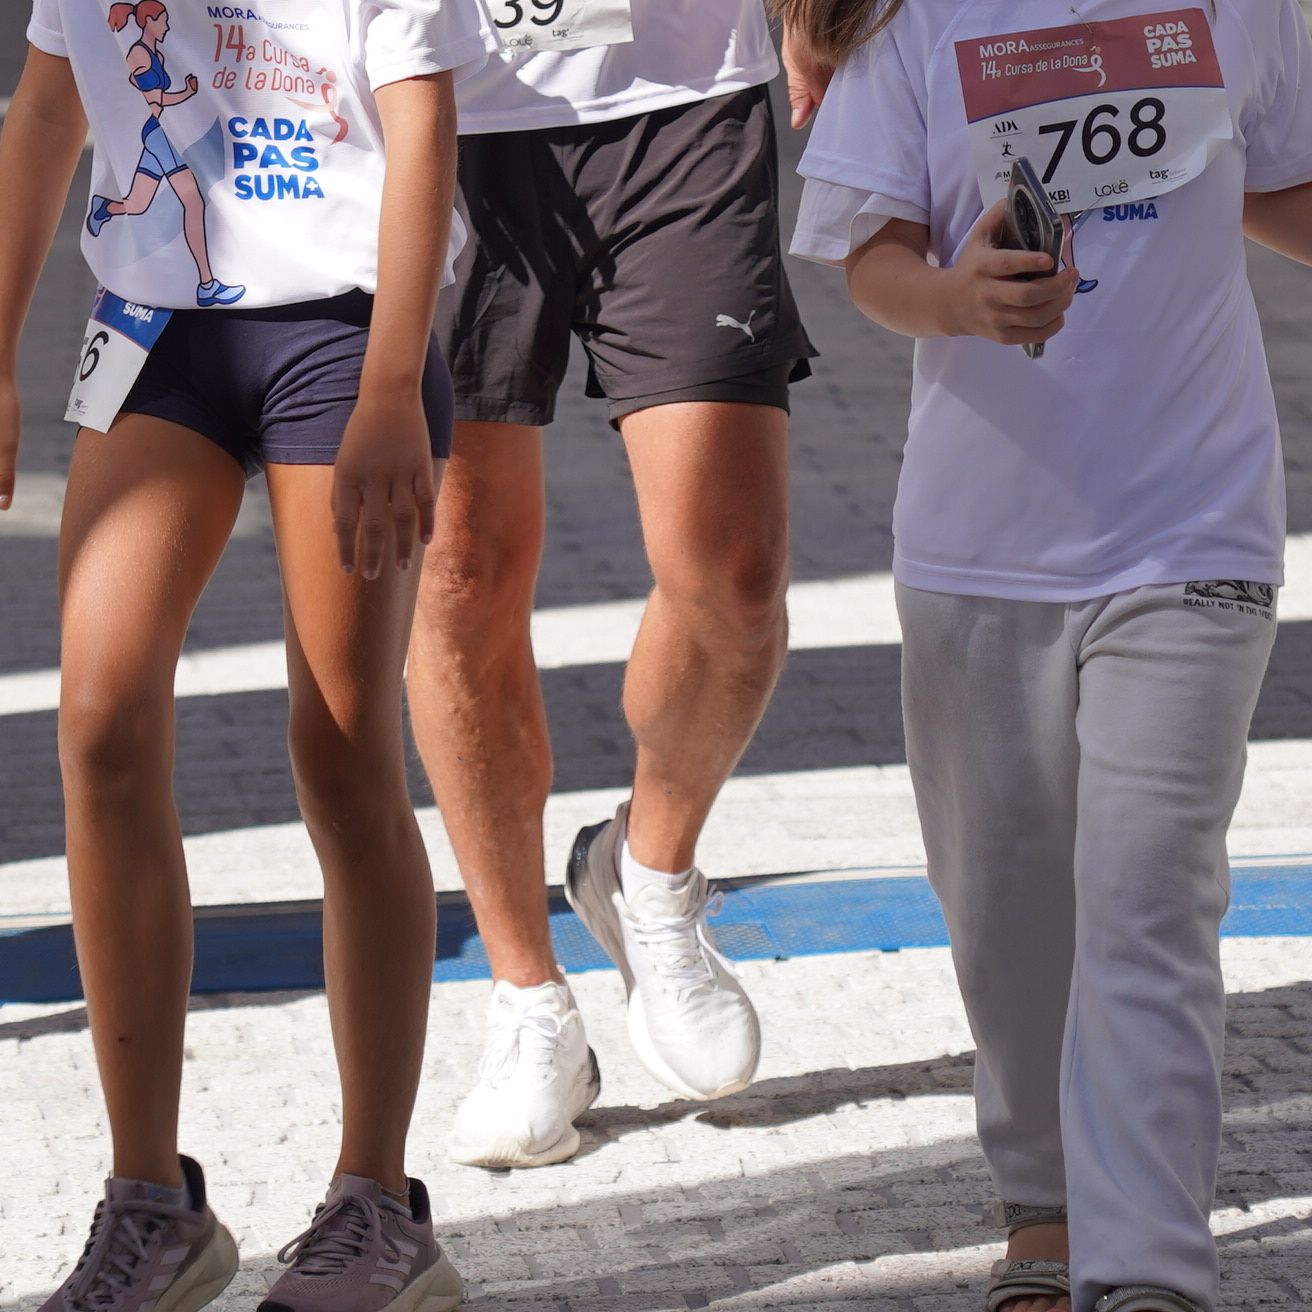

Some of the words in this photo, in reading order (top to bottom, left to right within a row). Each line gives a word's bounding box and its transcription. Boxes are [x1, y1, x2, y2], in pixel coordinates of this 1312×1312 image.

[207, 6, 258, 21] MORA
[1143, 21, 1189, 39] CADA
[979, 39, 1030, 59] MORA
[1029, 38, 1084, 52] ASSEGURANCES
[1146, 33, 1193, 54] PAS
[262, 39, 310, 73] Cursa
[1005, 63, 1033, 77] Cursa
[1035, 59, 1048, 73] de
[1050, 57, 1062, 70] la
[1062, 54, 1088, 69] Dona
[1150, 49, 1198, 70] SUMA
[212, 66, 237, 90] de
[245, 67, 266, 91] la
[271, 67, 316, 95] Dona
[228, 116, 314, 142] CADA
[993, 120, 1019, 135] ADA
[1038, 97, 1167, 185] 768
[232, 142, 319, 173] PAS
[1149, 168, 1167, 180] tag
[234, 174, 325, 201] SUMA
[1102, 202, 1159, 222] SUMA
[122, 302, 155, 323] SUMA
[1218, 601, 1234, 610] NOT
